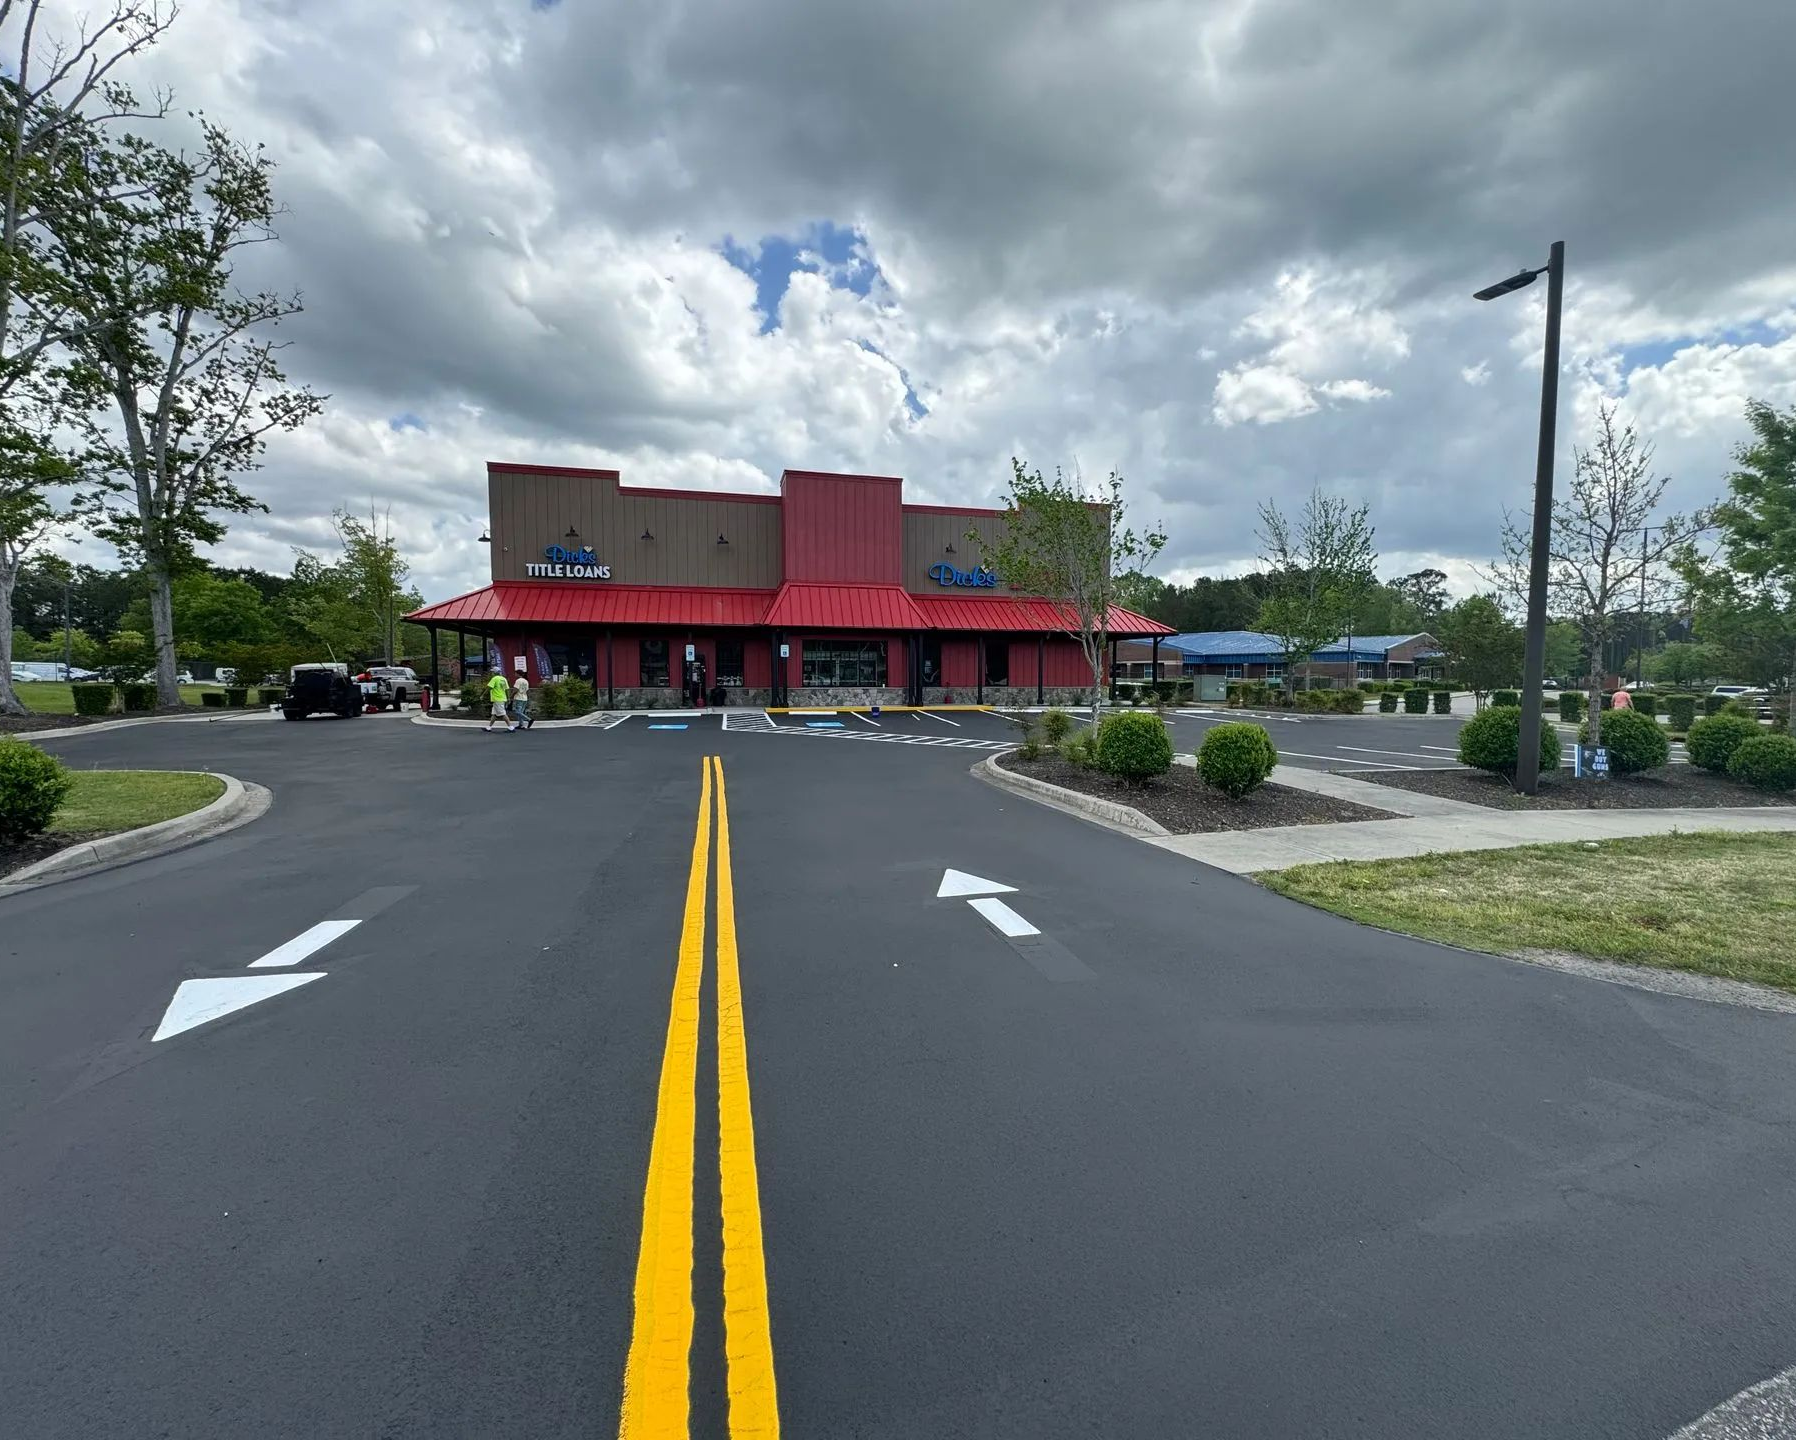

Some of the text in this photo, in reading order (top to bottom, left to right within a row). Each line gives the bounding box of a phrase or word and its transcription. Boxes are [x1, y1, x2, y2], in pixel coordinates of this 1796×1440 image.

[526, 563, 611, 579] TITLE LOANS
[1596, 748, 1606, 756] WE
[1594, 755, 1607, 763] BUY
[1592, 763, 1609, 771] GUNS
